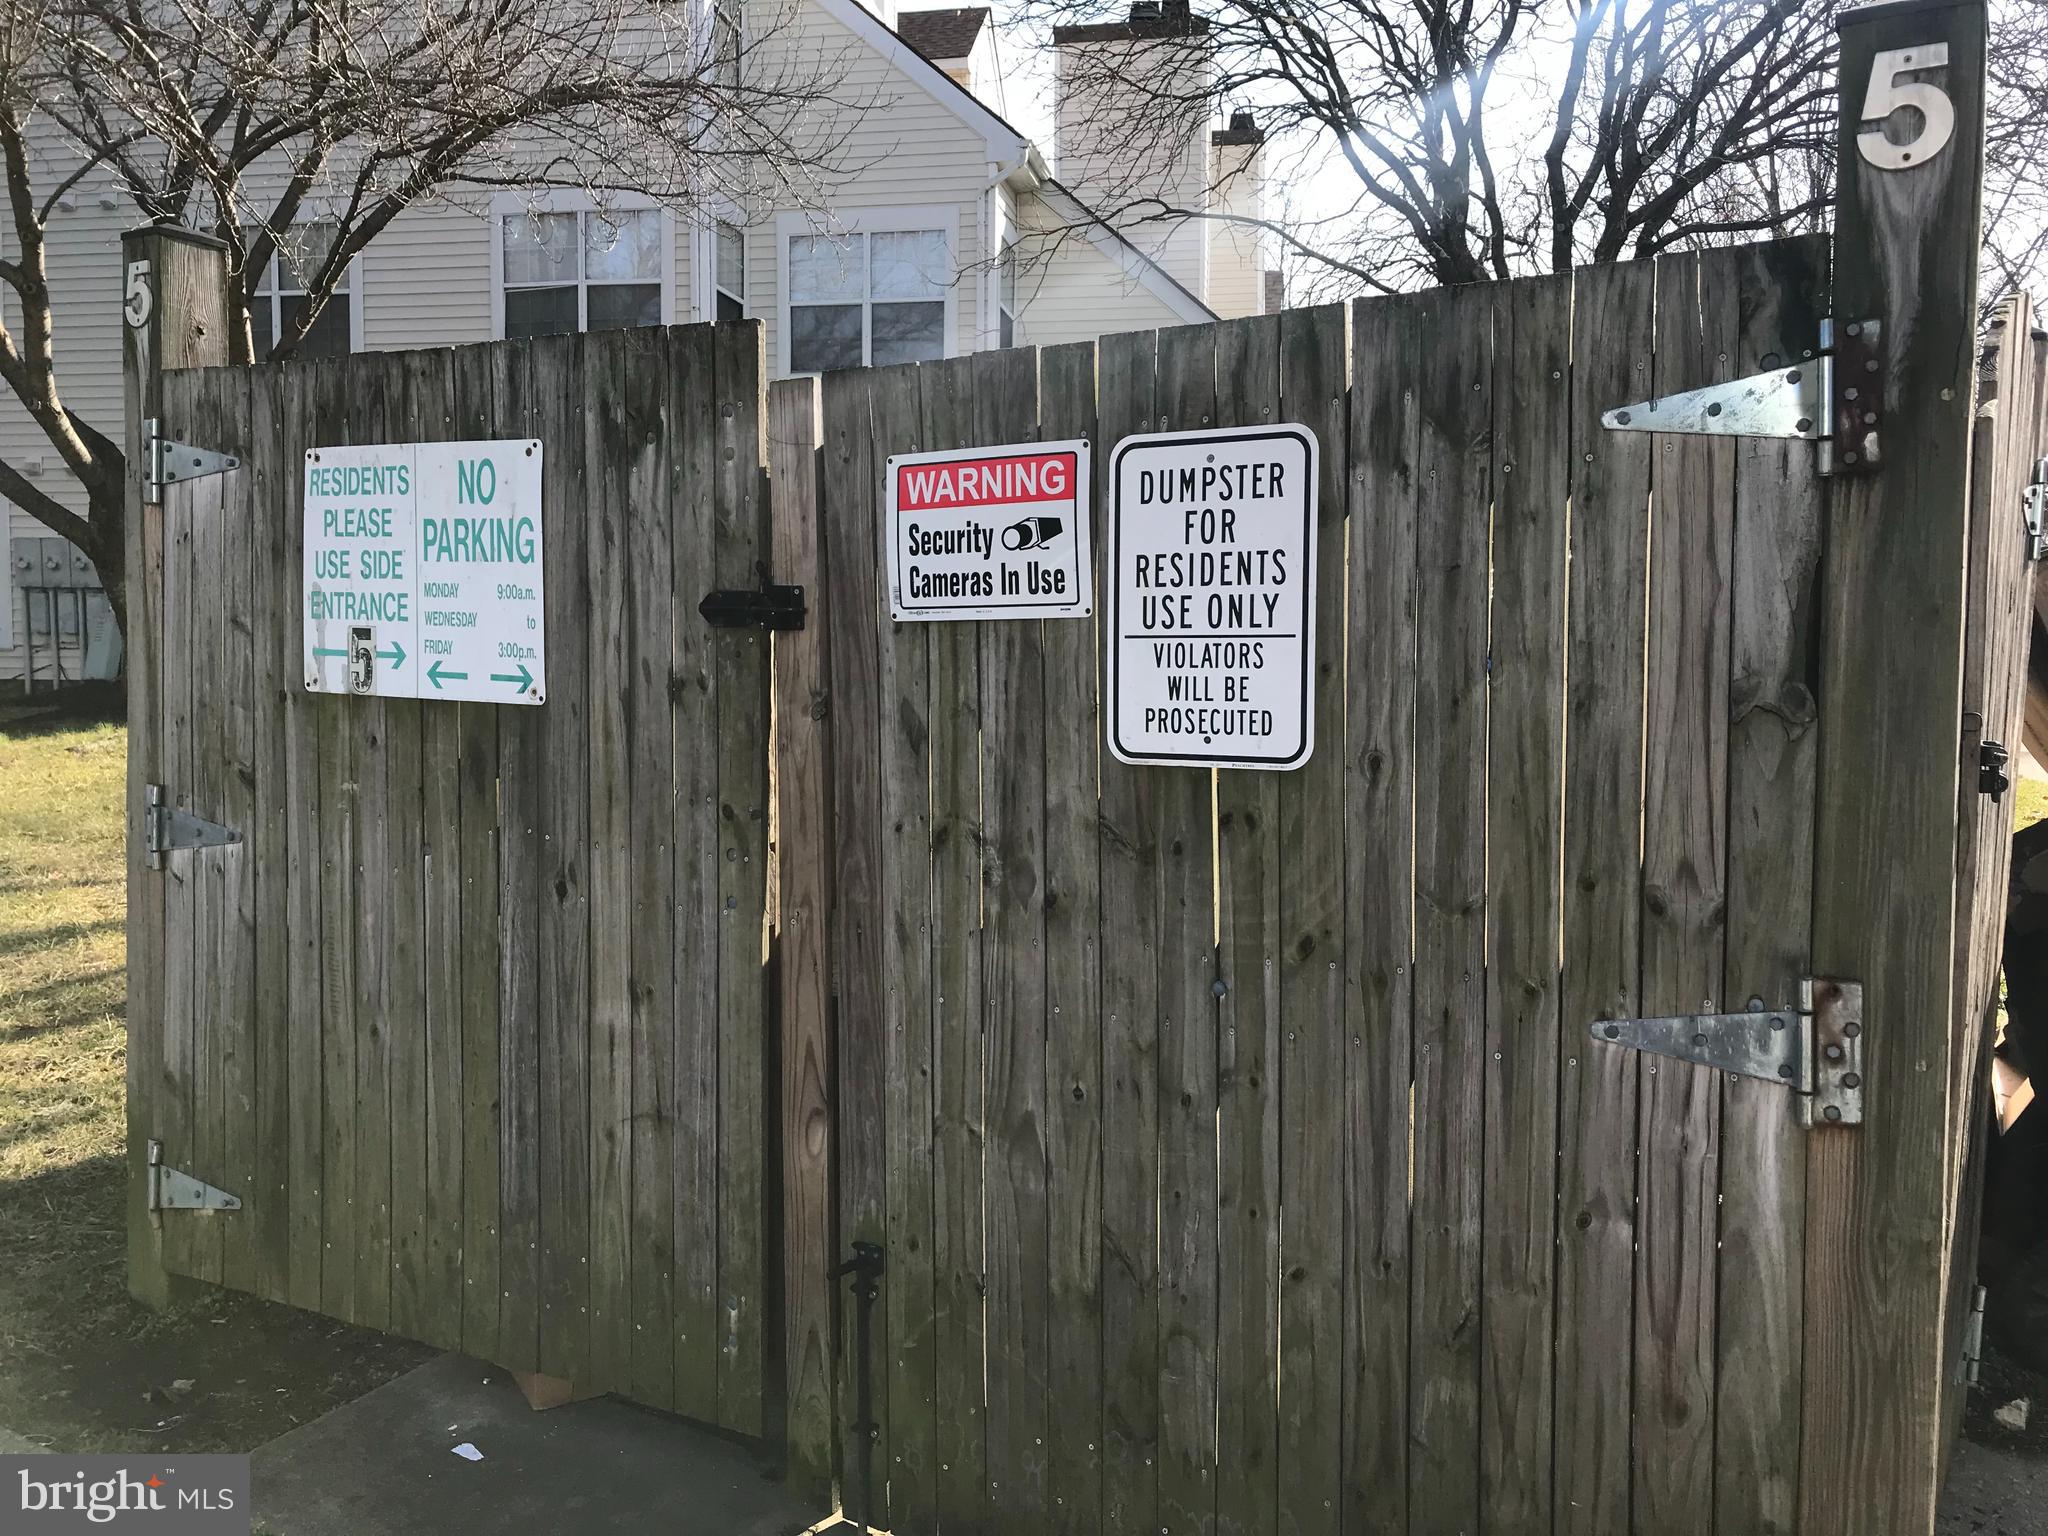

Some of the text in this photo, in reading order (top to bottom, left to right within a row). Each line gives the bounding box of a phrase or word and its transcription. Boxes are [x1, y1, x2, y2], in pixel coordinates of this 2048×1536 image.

[1856, 41, 1955, 170] 5
[124, 259, 153, 328] 5
[309, 464, 410, 497] RESIDENTS
[458, 458, 496, 505] NO
[906, 460, 1066, 504] WARNING
[1140, 462, 1285, 505] DUMPSTER
[323, 508, 393, 538] PLEASE
[423, 516, 535, 564] PARKING
[908, 520, 994, 560] Security
[1184, 508, 1236, 545] FOR
[315, 550, 403, 580] USE SIDE
[909, 565, 993, 598] Cameras
[1001, 562, 1020, 596] In
[1027, 561, 1066, 595] Use
[1136, 548, 1287, 588] RESIDENTS
[310, 591, 409, 622] ENTRANCE
[424, 582, 536, 600] MONDAY 9:00a.m.
[424, 611, 536, 630] WEDNESDAY to
[1142, 593, 1280, 630] USE ONLY
[351, 627, 374, 694] 5
[424, 639, 537, 661] FRIDAY 3:00p.m.
[1153, 642, 1264, 669] VIOLATORS
[1167, 676, 1250, 702] WILL BE
[1145, 708, 1273, 736] PROSECUTED
